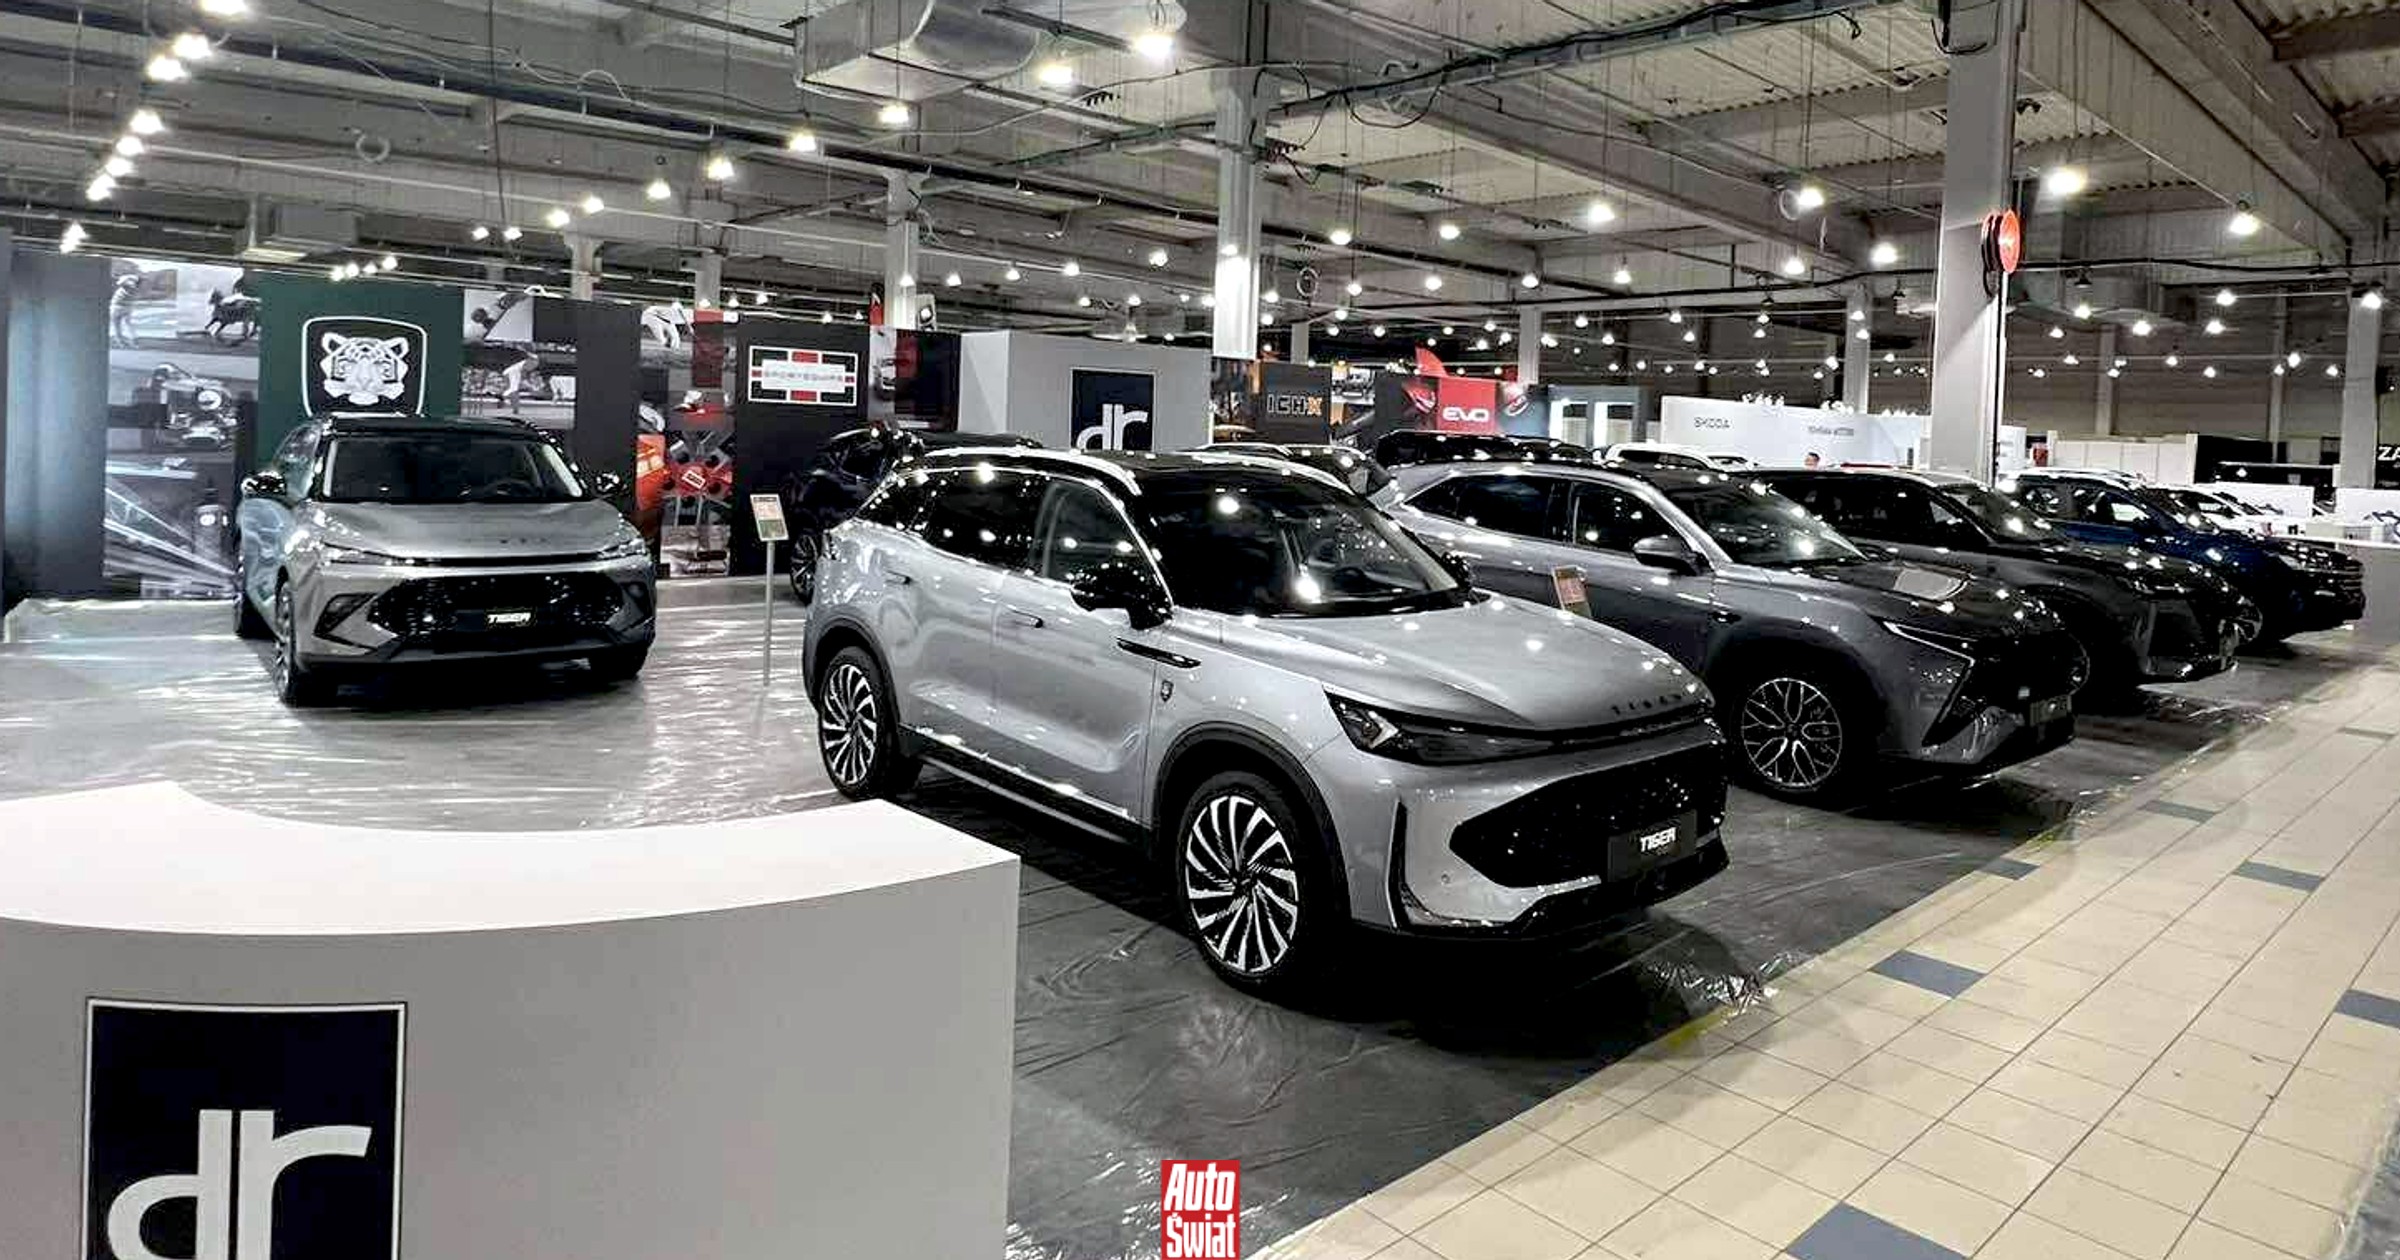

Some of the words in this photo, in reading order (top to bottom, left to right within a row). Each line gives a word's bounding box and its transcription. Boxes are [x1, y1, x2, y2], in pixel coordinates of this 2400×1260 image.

[1442, 406, 1490, 422] EVO
[1640, 826, 1678, 852] TIGER
[106, 1109, 373, 1260] dr
